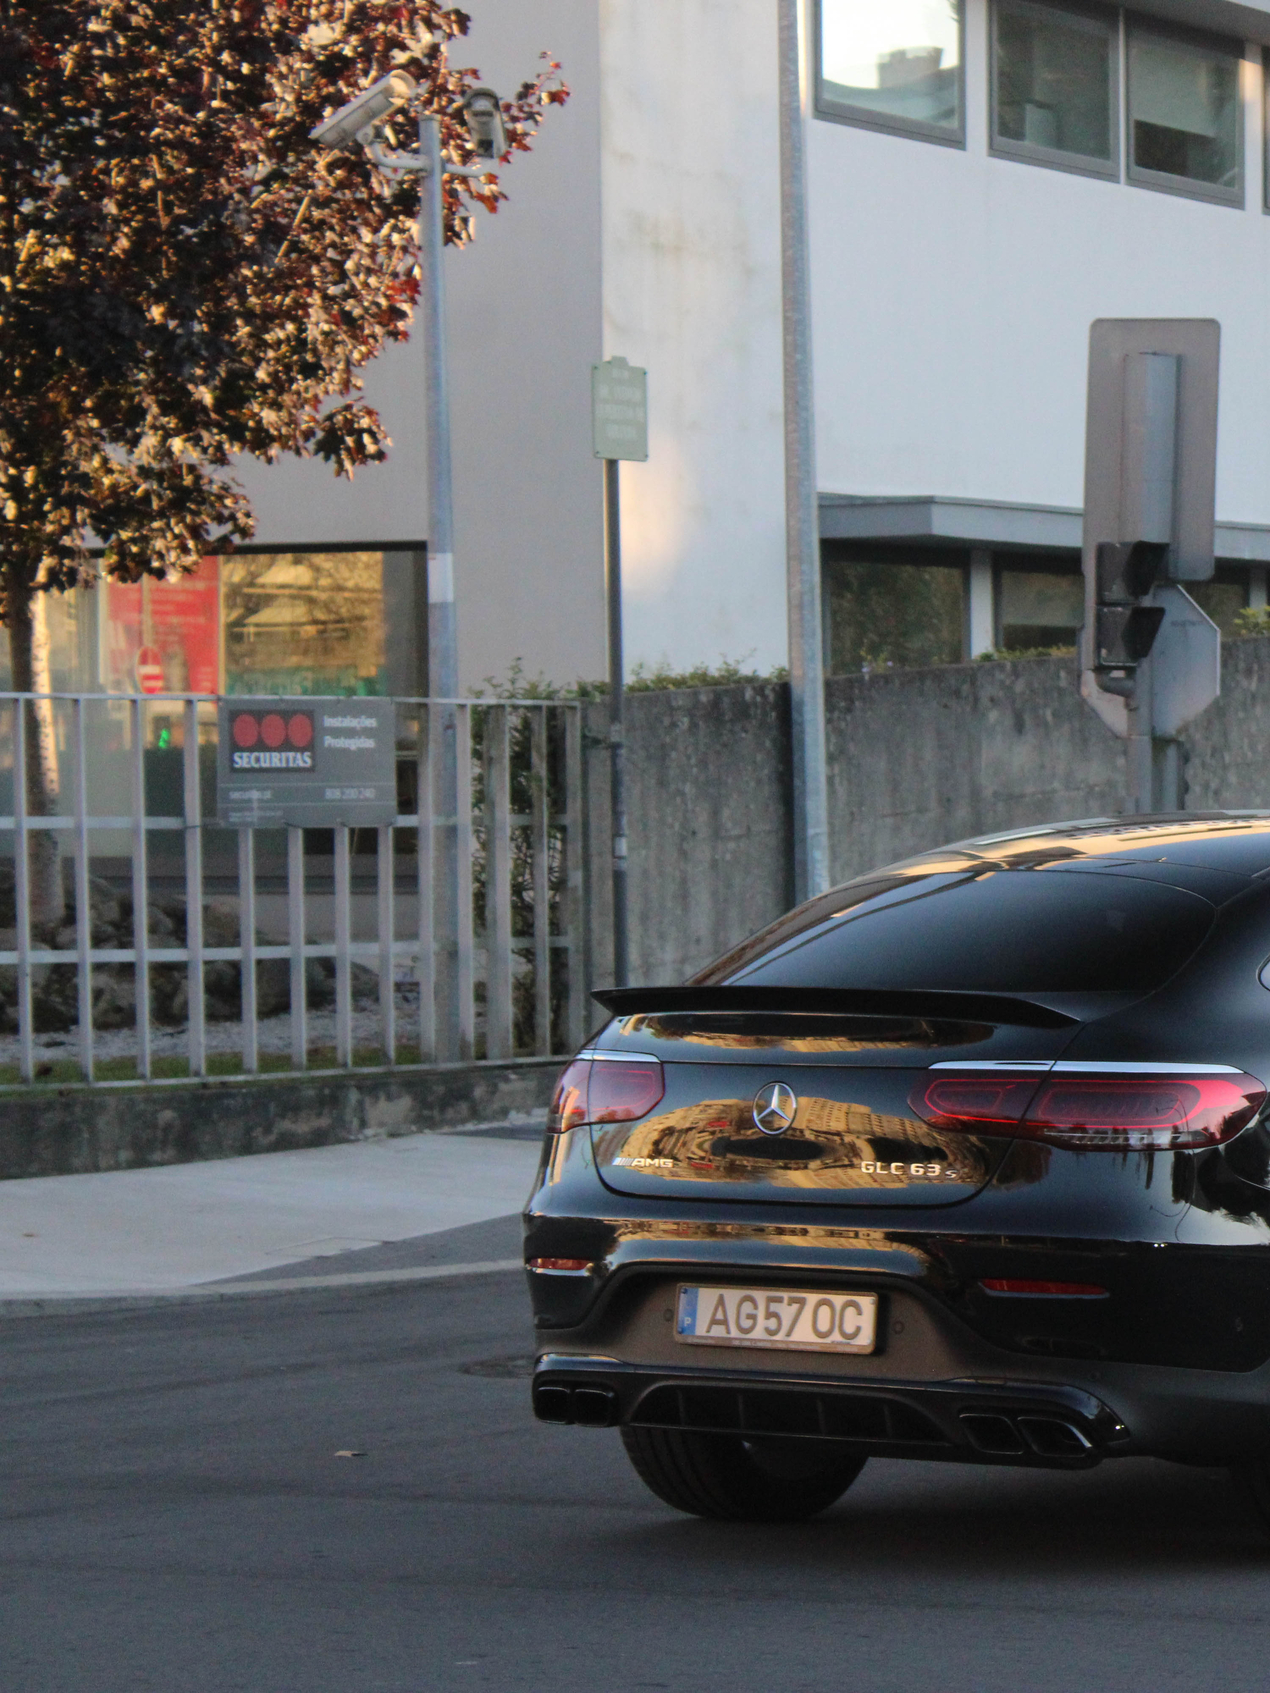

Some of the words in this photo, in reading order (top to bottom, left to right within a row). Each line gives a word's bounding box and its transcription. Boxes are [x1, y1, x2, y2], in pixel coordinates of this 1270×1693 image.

[323, 715, 377, 730] Instalações
[324, 736, 375, 750] Protegidas
[233, 752, 312, 768] SECURITAS
[631, 1158, 673, 1168] AMG
[861, 1161, 904, 1175] GLC
[911, 1163, 940, 1176] 63
[684, 1317, 692, 1327] P
